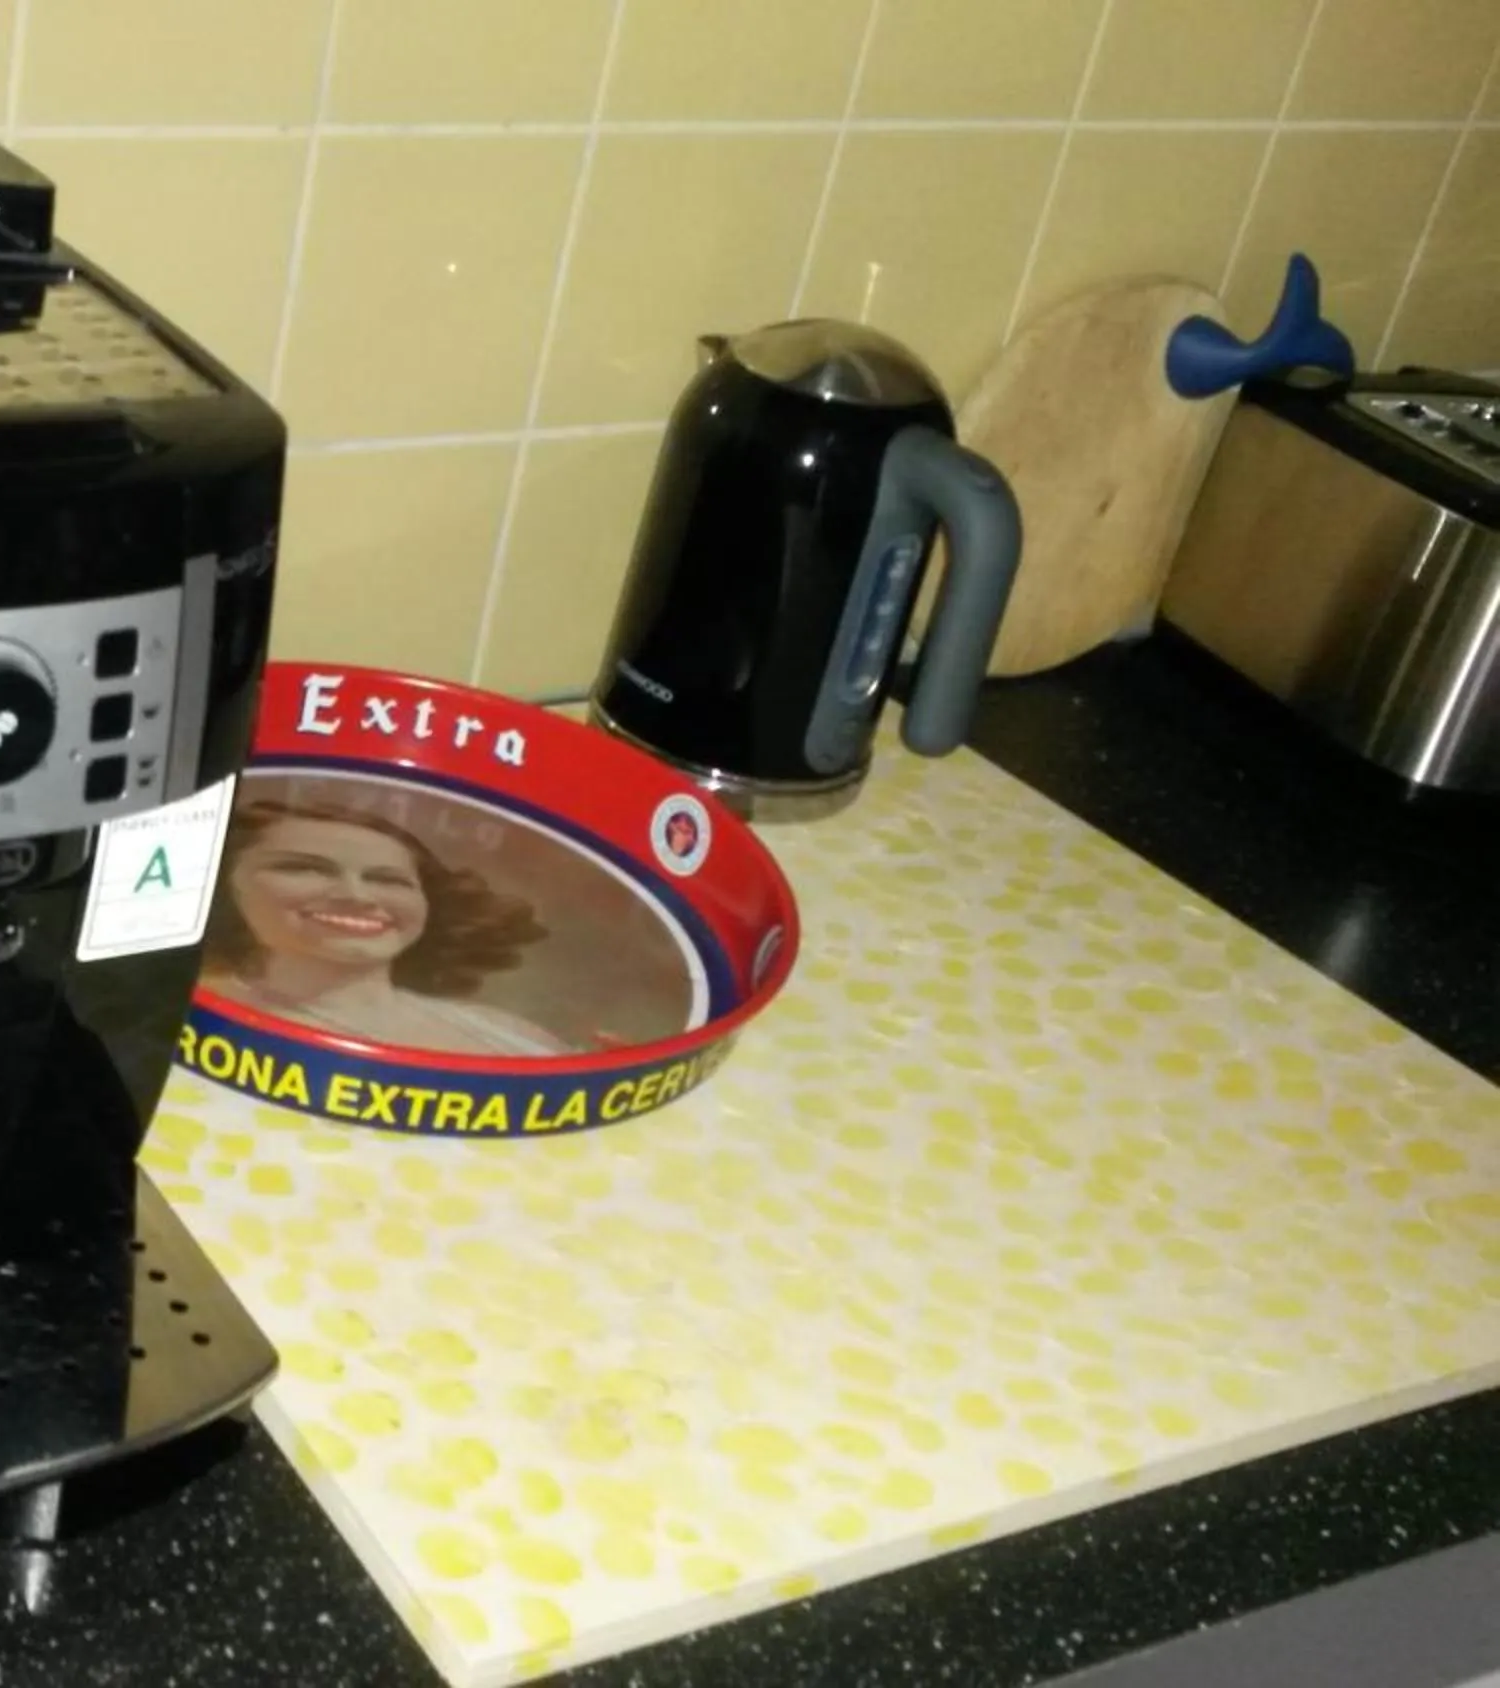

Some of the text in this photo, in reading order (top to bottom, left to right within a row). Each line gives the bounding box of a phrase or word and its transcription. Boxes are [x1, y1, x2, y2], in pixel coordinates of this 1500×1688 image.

[296, 673, 526, 767] Extra
[133, 845, 172, 893] A
[178, 1024, 310, 1106] RONA
[324, 1072, 509, 1133] EXTRA
[522, 1089, 588, 1132] LA
